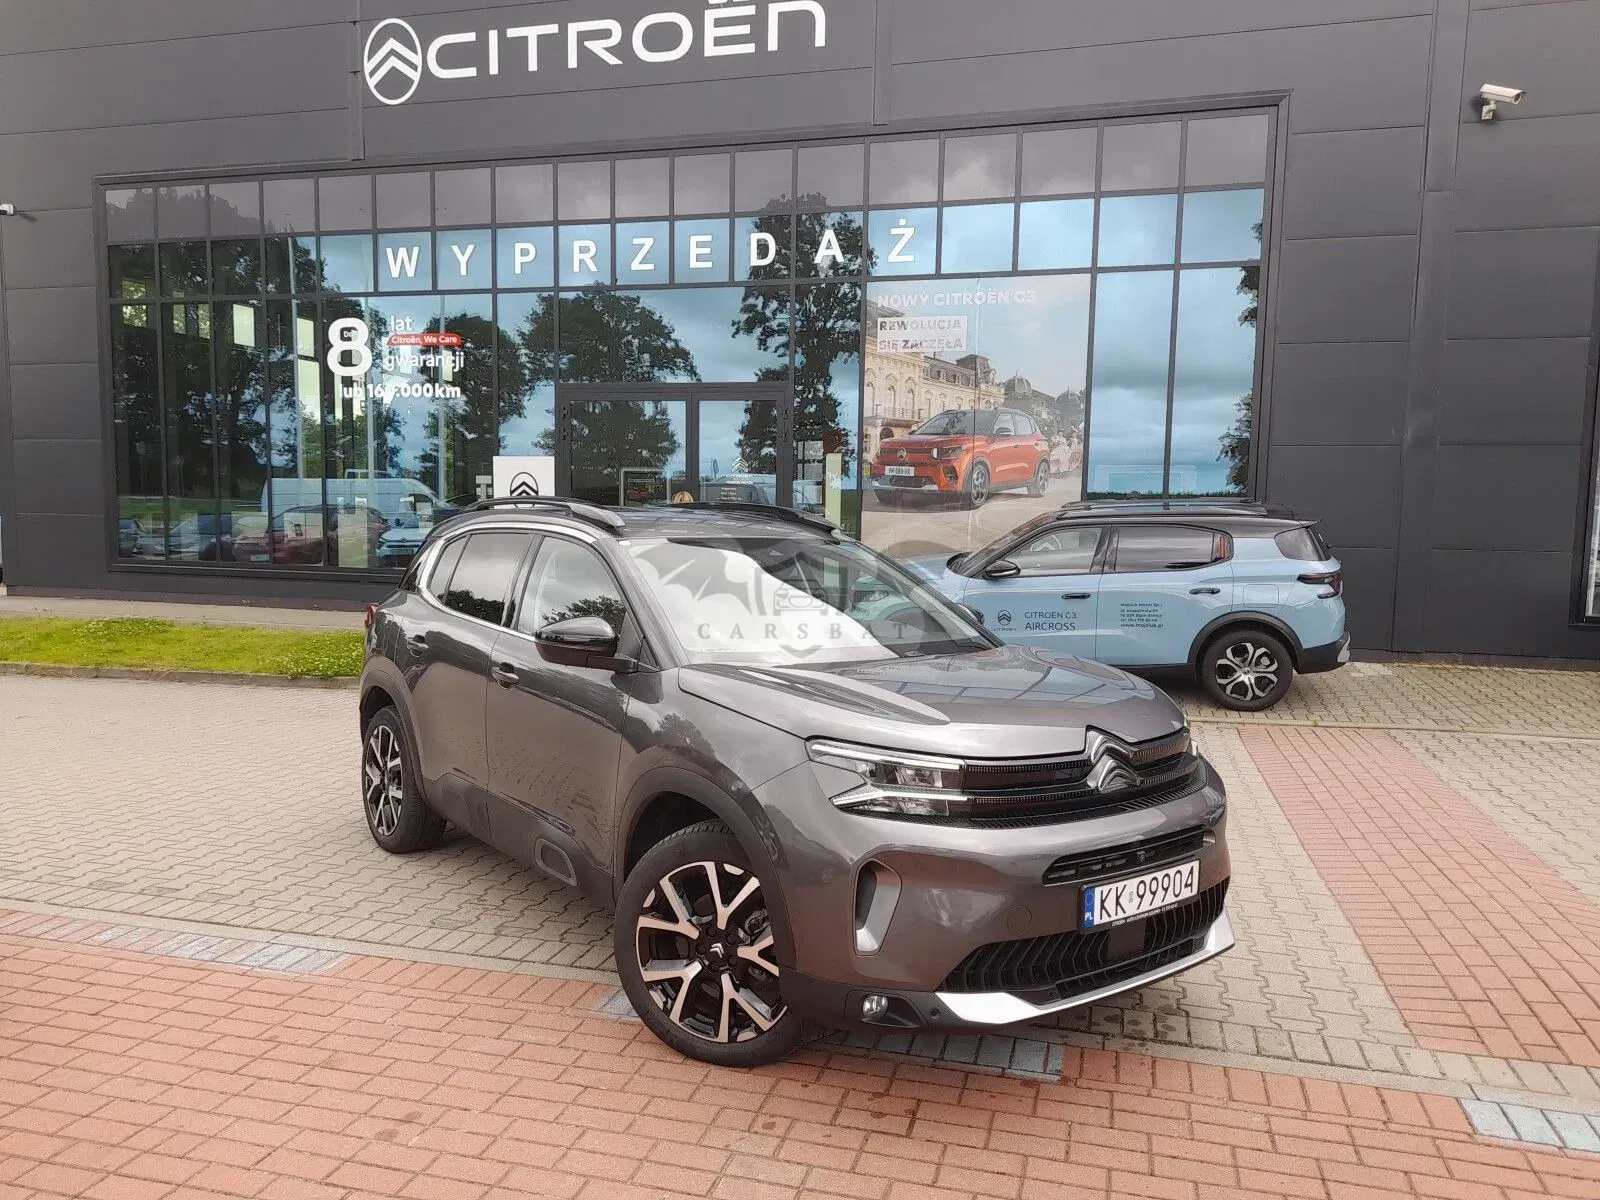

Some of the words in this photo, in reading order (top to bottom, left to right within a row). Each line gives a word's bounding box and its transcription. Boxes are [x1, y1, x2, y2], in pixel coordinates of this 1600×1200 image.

[877, 293, 930, 308] NOWY
[1013, 289, 1036, 304] C3
[390, 315, 413, 331] lat
[879, 319, 962, 331] REWOLUCJA
[424, 335, 438, 344] We
[439, 334, 458, 344] Care
[327, 317, 373, 377] 8
[385, 351, 465, 371] gwarancji
[339, 383, 365, 398] lub
[1065, 611, 1077, 619] C3
[1024, 621, 1076, 631] AIRCROSS
[1099, 884, 1127, 920] KK
[1136, 865, 1194, 910] 99904
[1084, 912, 1094, 922] PL
